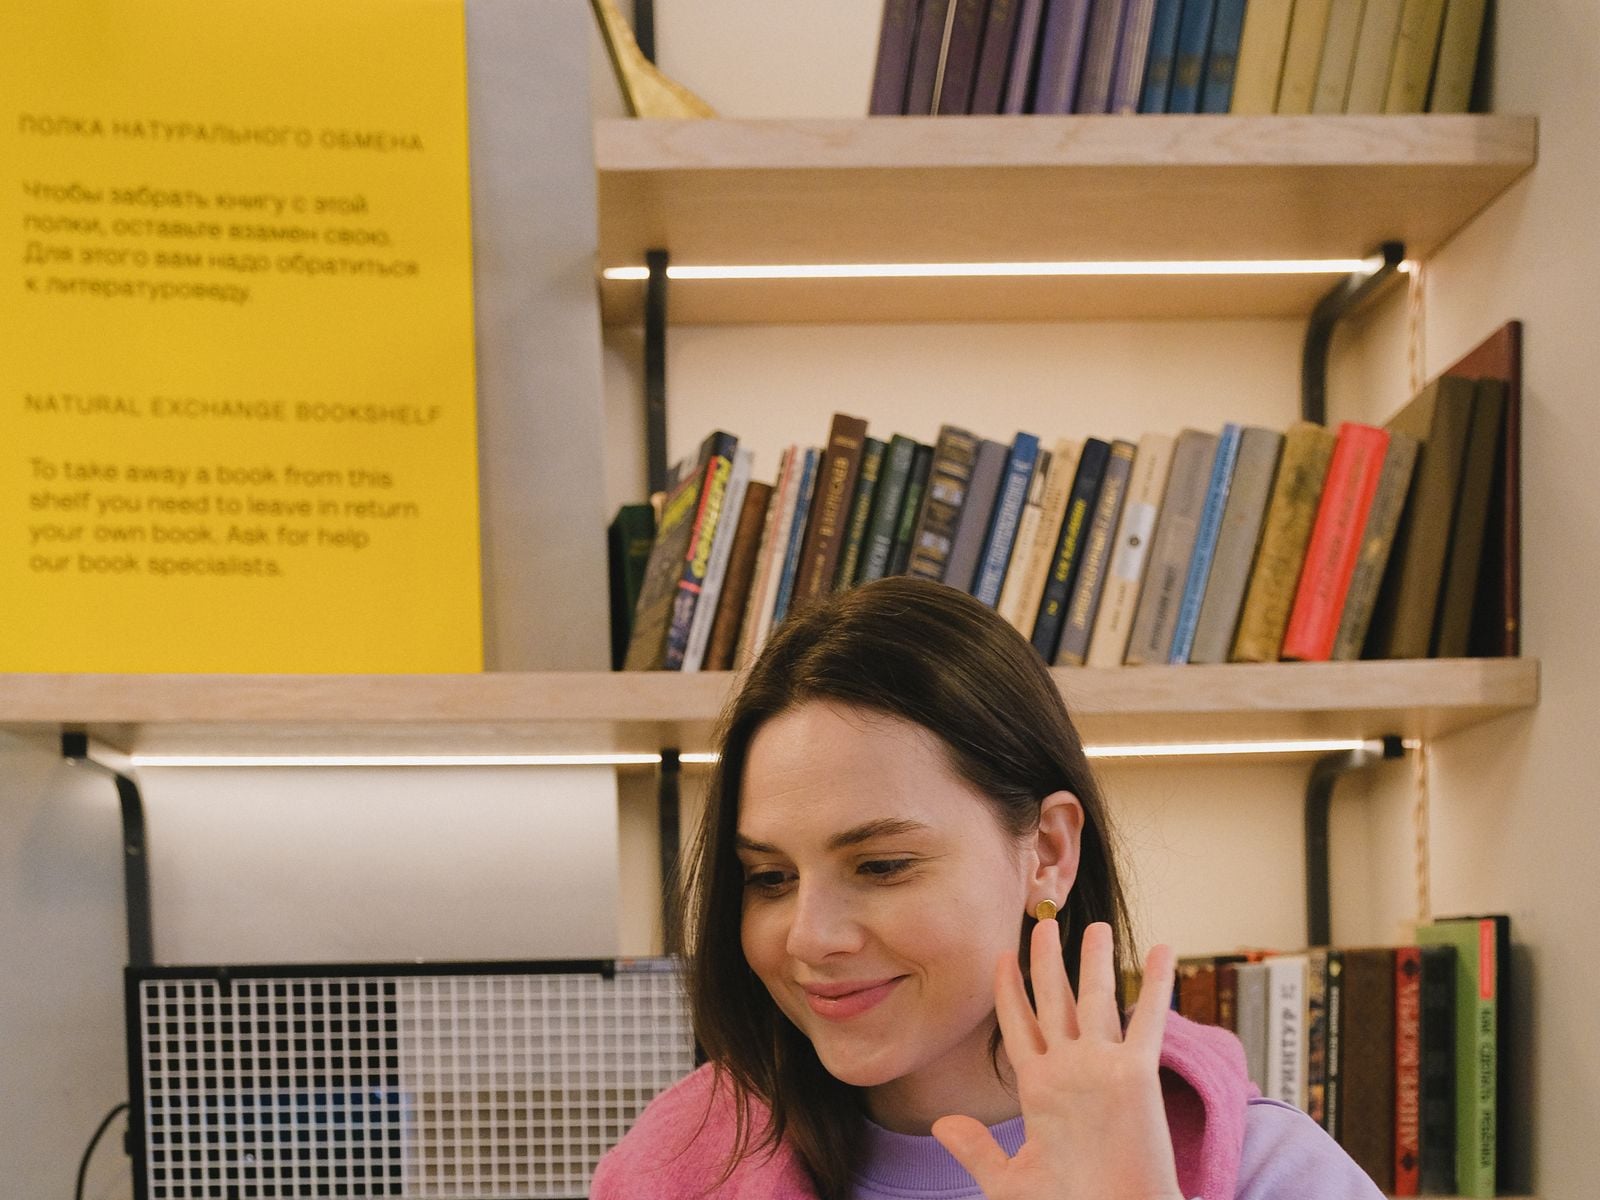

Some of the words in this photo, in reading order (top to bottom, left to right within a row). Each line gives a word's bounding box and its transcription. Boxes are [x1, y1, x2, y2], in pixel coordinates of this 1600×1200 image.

[19, 114, 105, 137] ПОЛКА
[112, 119, 313, 149] НАТУРАЛЬНОГО
[319, 129, 424, 152] ОБМЕНА
[22, 182, 104, 204] Чтобы
[110, 185, 209, 209] забрать
[215, 194, 286, 216] книгу
[291, 196, 307, 214] с
[314, 194, 368, 215] этой
[23, 214, 107, 240] полки,
[112, 219, 223, 239] оставьте
[228, 224, 318, 243] взамен
[23, 241, 73, 265] Для
[80, 247, 150, 268] этого
[154, 251, 203, 268] вам
[208, 253, 271, 273] надо
[276, 252, 419, 277] обратиться
[25, 278, 38, 294] к
[24, 393, 141, 417] NATURAL
[150, 396, 285, 421] EXCHANGE
[294, 401, 441, 426] BOOKSHELF
[30, 457, 58, 480] To
[63, 462, 119, 482] take
[125, 465, 190, 487] away
[195, 467, 211, 484] a
[216, 465, 278, 486] book
[284, 464, 343, 487] from
[347, 468, 394, 489] this
[29, 490, 91, 511] shelf
[96, 495, 142, 517] you
[147, 496, 210, 514] need
[215, 495, 243, 516] to
[247, 497, 312, 517] leave
[317, 499, 339, 516] in
[344, 500, 419, 519] return
[28, 523, 85, 546] your
[94, 525, 146, 542] own
[151, 523, 216, 544] book.
[226, 524, 269, 546] Ask
[276, 524, 311, 546] for
[317, 527, 370, 551] help
[29, 554, 71, 573] our
[78, 553, 140, 574] book
[147, 556, 282, 577] specialists.
